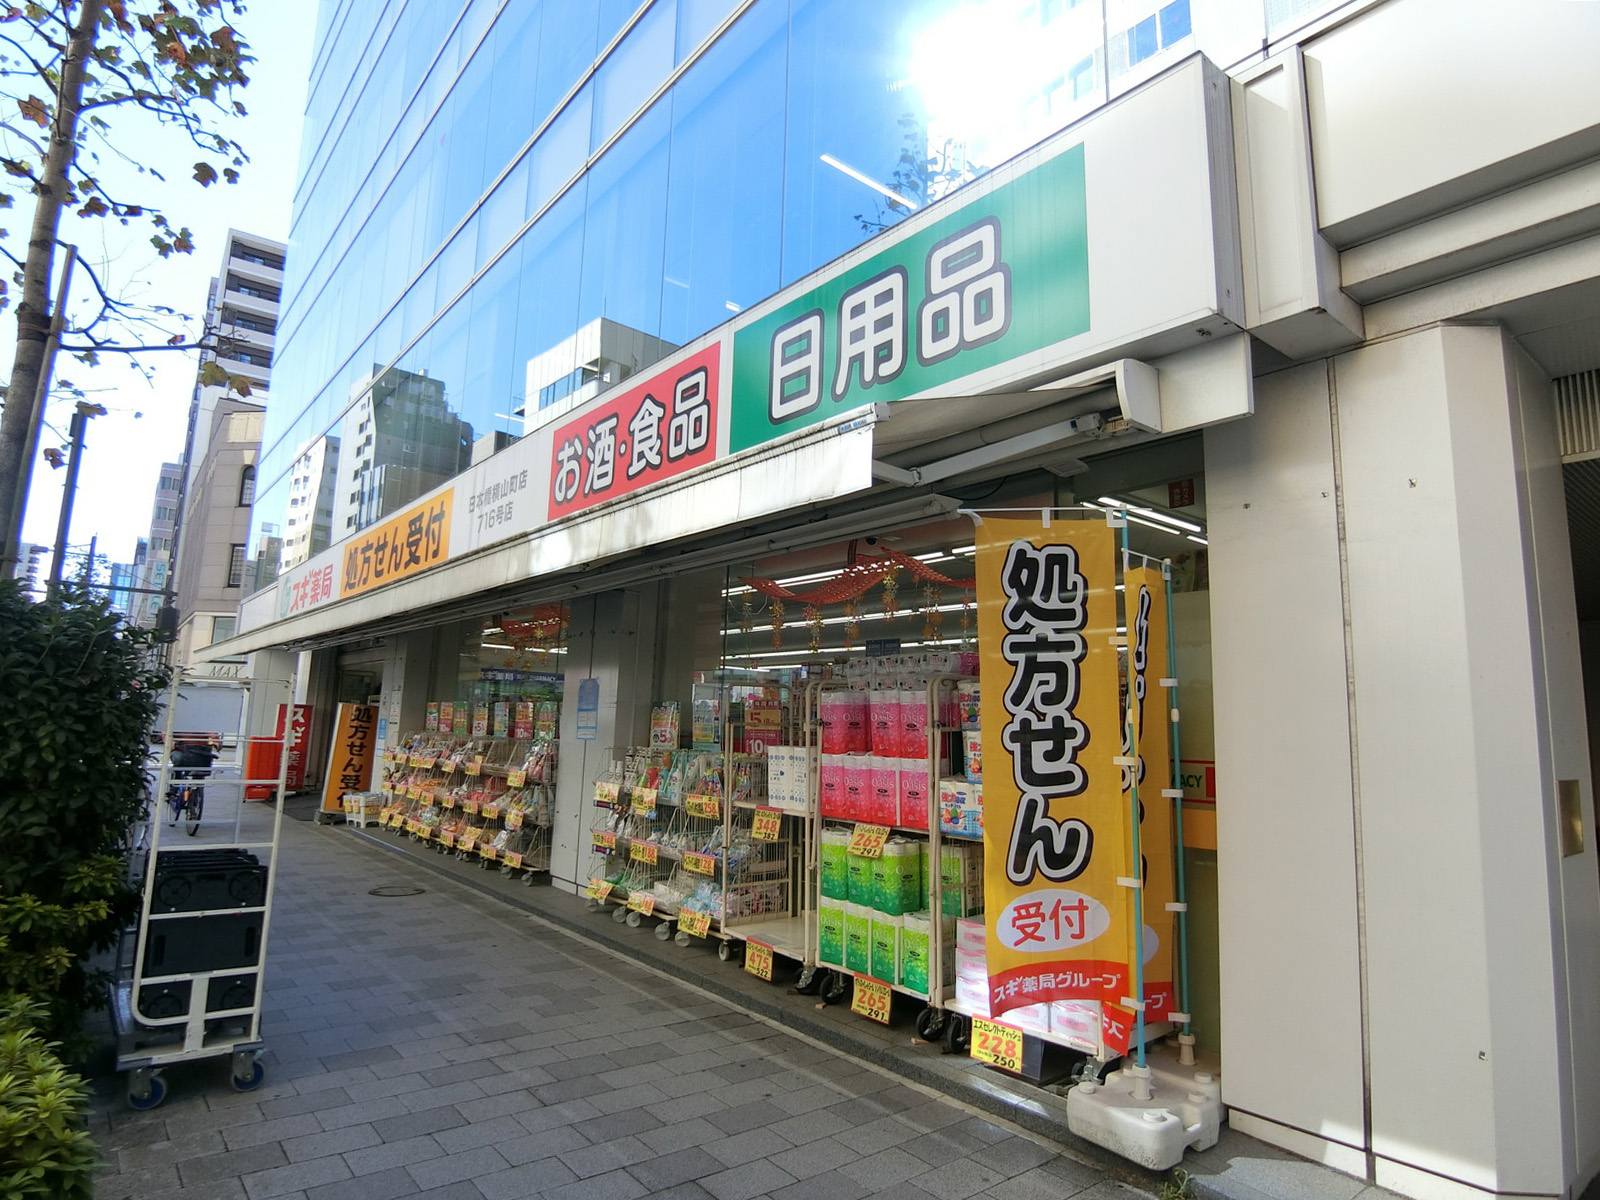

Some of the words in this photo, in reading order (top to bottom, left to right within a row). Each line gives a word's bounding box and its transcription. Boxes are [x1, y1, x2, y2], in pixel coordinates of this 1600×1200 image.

[768, 215, 1012, 425] 日用品
[554, 366, 710, 505] お酒・食品
[469, 470, 528, 513] 日本橋横山町店
[478, 501, 513, 533] 716号店
[345, 501, 445, 592] 処方せん受付
[290, 564, 333, 612] スギ薬局
[209, 665, 245, 678] MAX
[1001, 541, 1093, 886] 処方せん
[902, 779, 927, 792] Oasis
[756, 818, 778, 833] 348
[853, 832, 883, 849] 265
[1011, 898, 1089, 946] 受付
[750, 951, 769, 970] 475
[857, 988, 887, 1011] 265
[994, 973, 1121, 1003] スギ薬局グループ
[867, 1007, 885, 1021] 291
